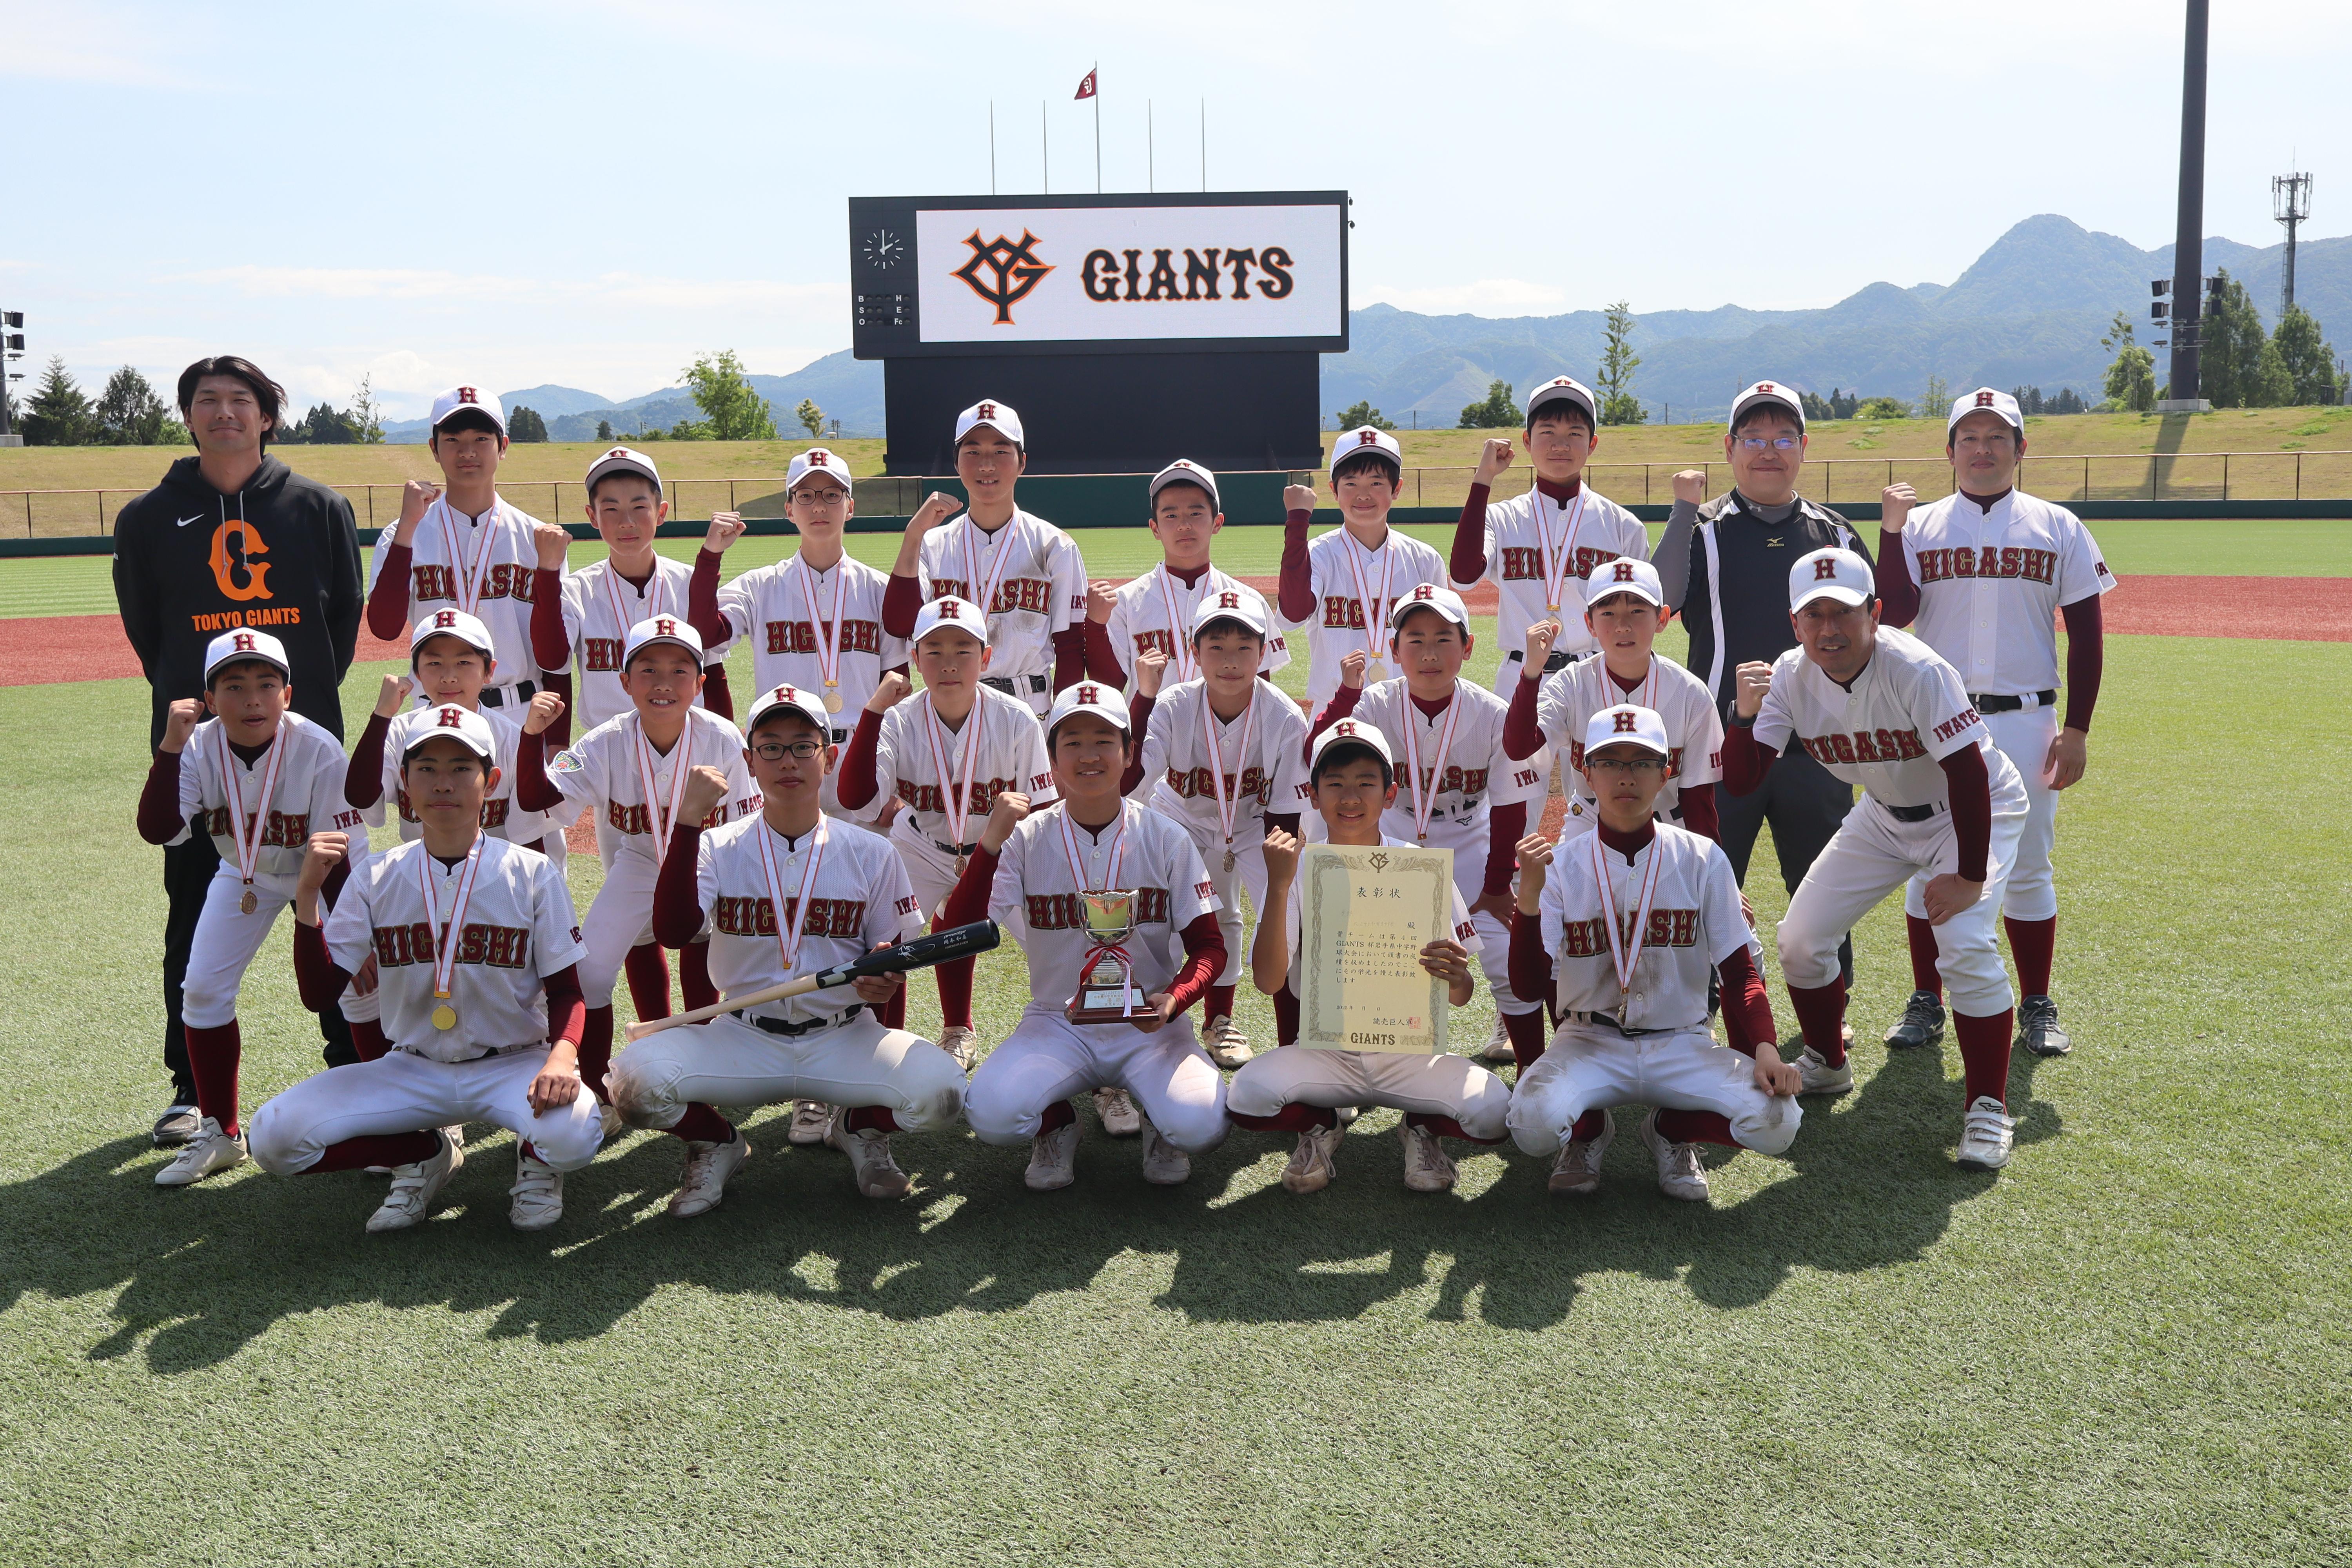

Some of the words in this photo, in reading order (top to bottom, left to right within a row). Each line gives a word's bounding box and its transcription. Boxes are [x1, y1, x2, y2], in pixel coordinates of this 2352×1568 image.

[1080, 246, 1294, 302] GIANTS
[457, 387, 479, 403] H
[1975, 391, 1994, 407] H
[977, 404, 996, 420] H
[1358, 430, 1377, 446] H
[809, 451, 828, 466] H
[1613, 563, 1635, 582] H
[1813, 558, 1836, 581] H
[1916, 547, 2057, 585] HIGASHI
[1218, 592, 1240, 609] H
[1413, 585, 1434, 601] H
[938, 601, 960, 619] H
[192, 610, 243, 632] TOKYO
[246, 607, 301, 626] GIANTS
[434, 611, 457, 629] H
[655, 619, 677, 636] H
[233, 633, 257, 652] H
[774, 687, 797, 703] H
[1076, 686, 1100, 705] H
[437, 708, 463, 729] H
[1612, 712, 1637, 733] H
[1933, 708, 1980, 743] IWATE
[1335, 722, 1358, 737] H
[1356, 886, 1401, 898] 表彰状
[1336, 949, 1416, 960] 球大会において頭書の成
[1336, 960, 1415, 968] 績を収めましたのでここ
[1350, 1032, 1396, 1045] GIANTS
